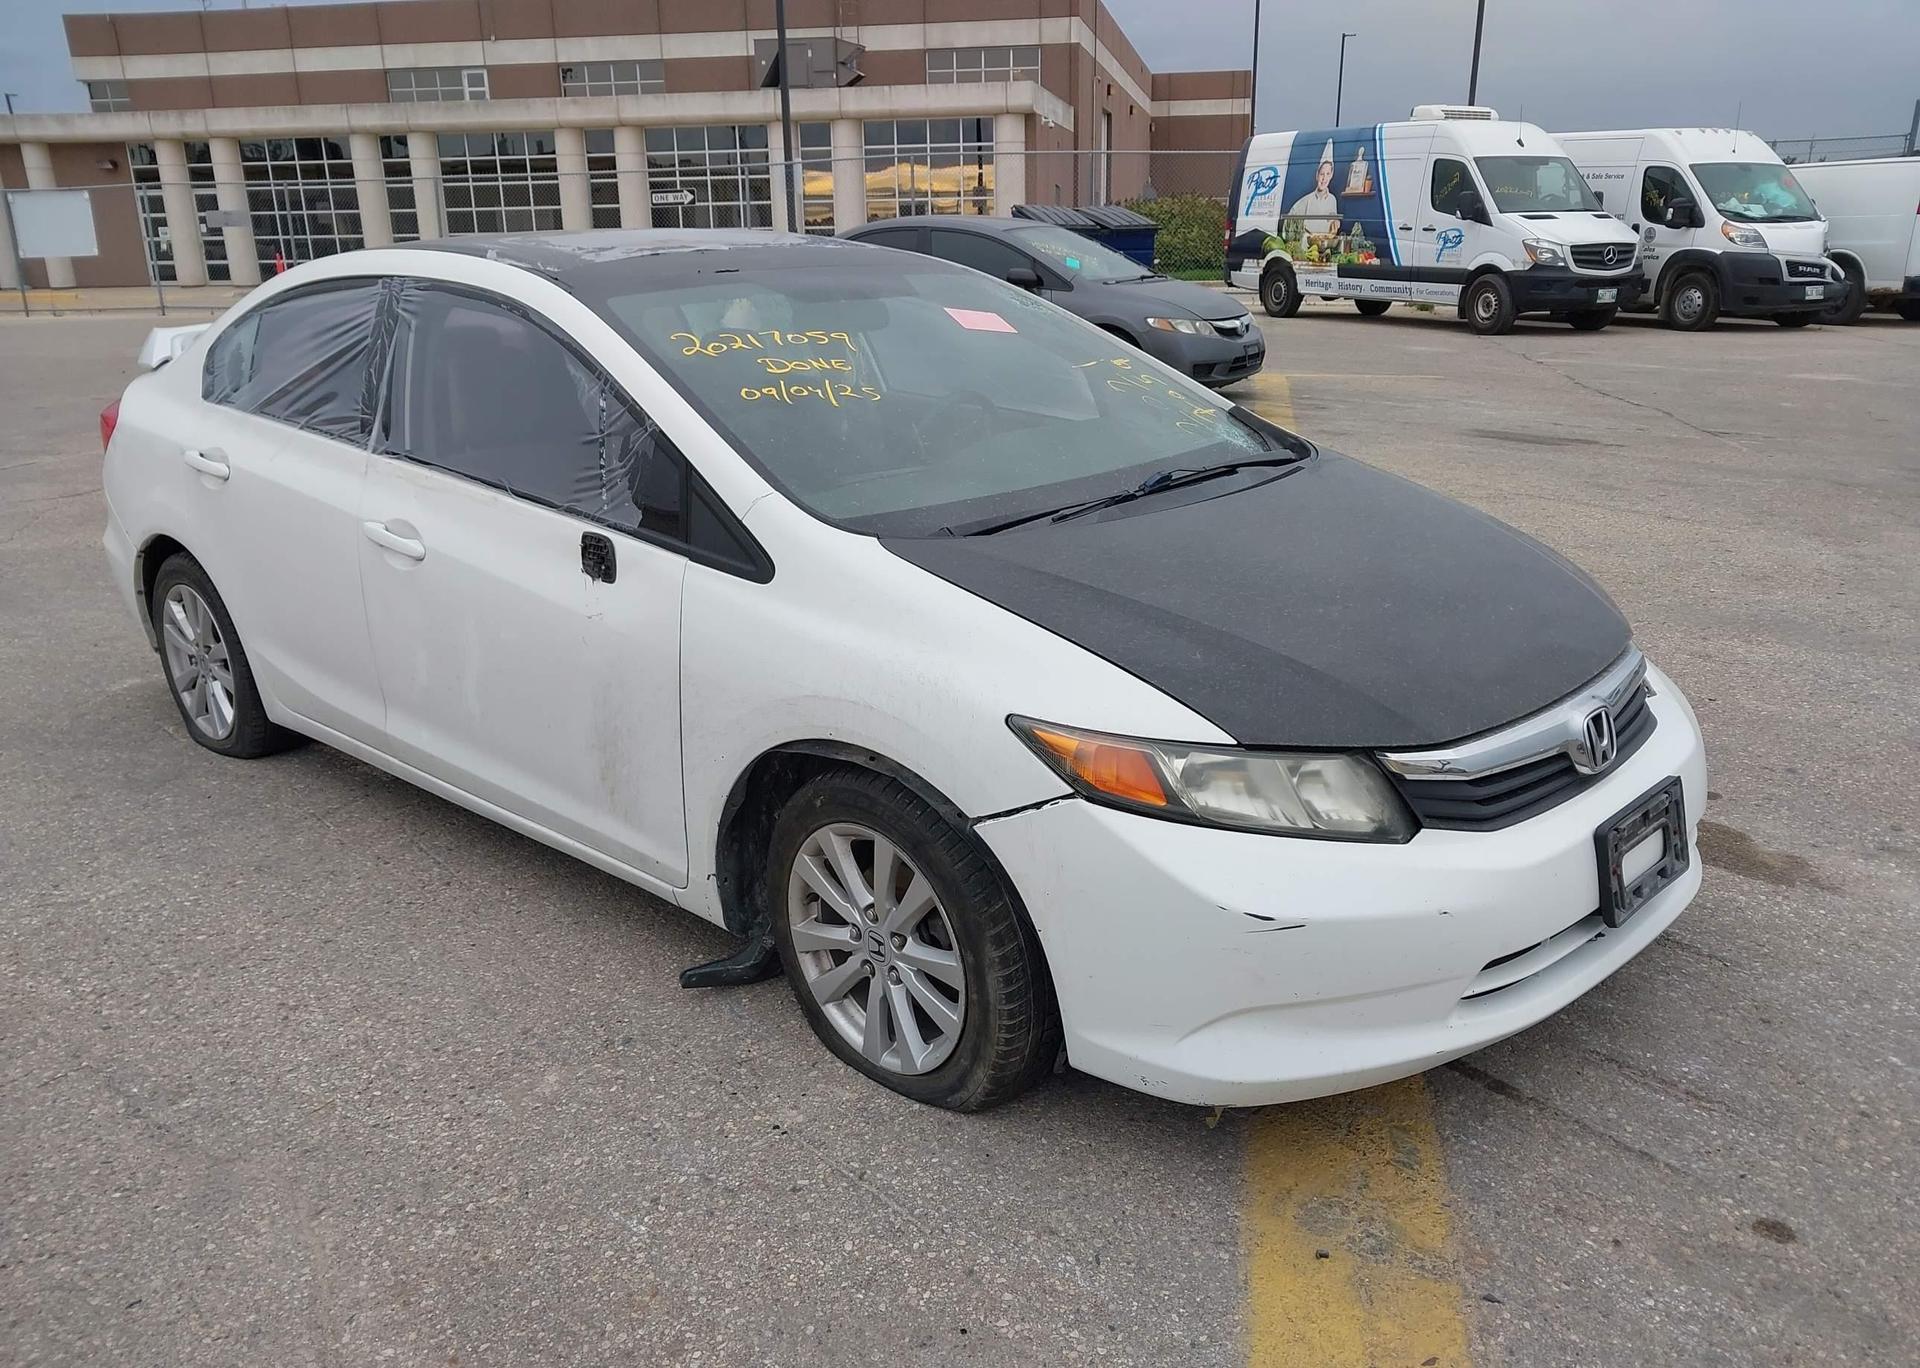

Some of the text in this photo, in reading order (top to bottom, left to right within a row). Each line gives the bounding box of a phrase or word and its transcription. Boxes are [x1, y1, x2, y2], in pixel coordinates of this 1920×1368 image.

[1591, 172, 1603, 180] Safe
[1604, 172, 1625, 180] Service
[654, 193, 689, 202] ONE WAY
[1798, 265, 1821, 274] RAM
[1305, 278, 1334, 291] Heritage.
[1338, 281, 1366, 293] History.
[1369, 283, 1415, 297] Community.
[670, 330, 857, 357] 20217059
[757, 357, 853, 374] DONE
[740, 379, 882, 408] 09/04/25
